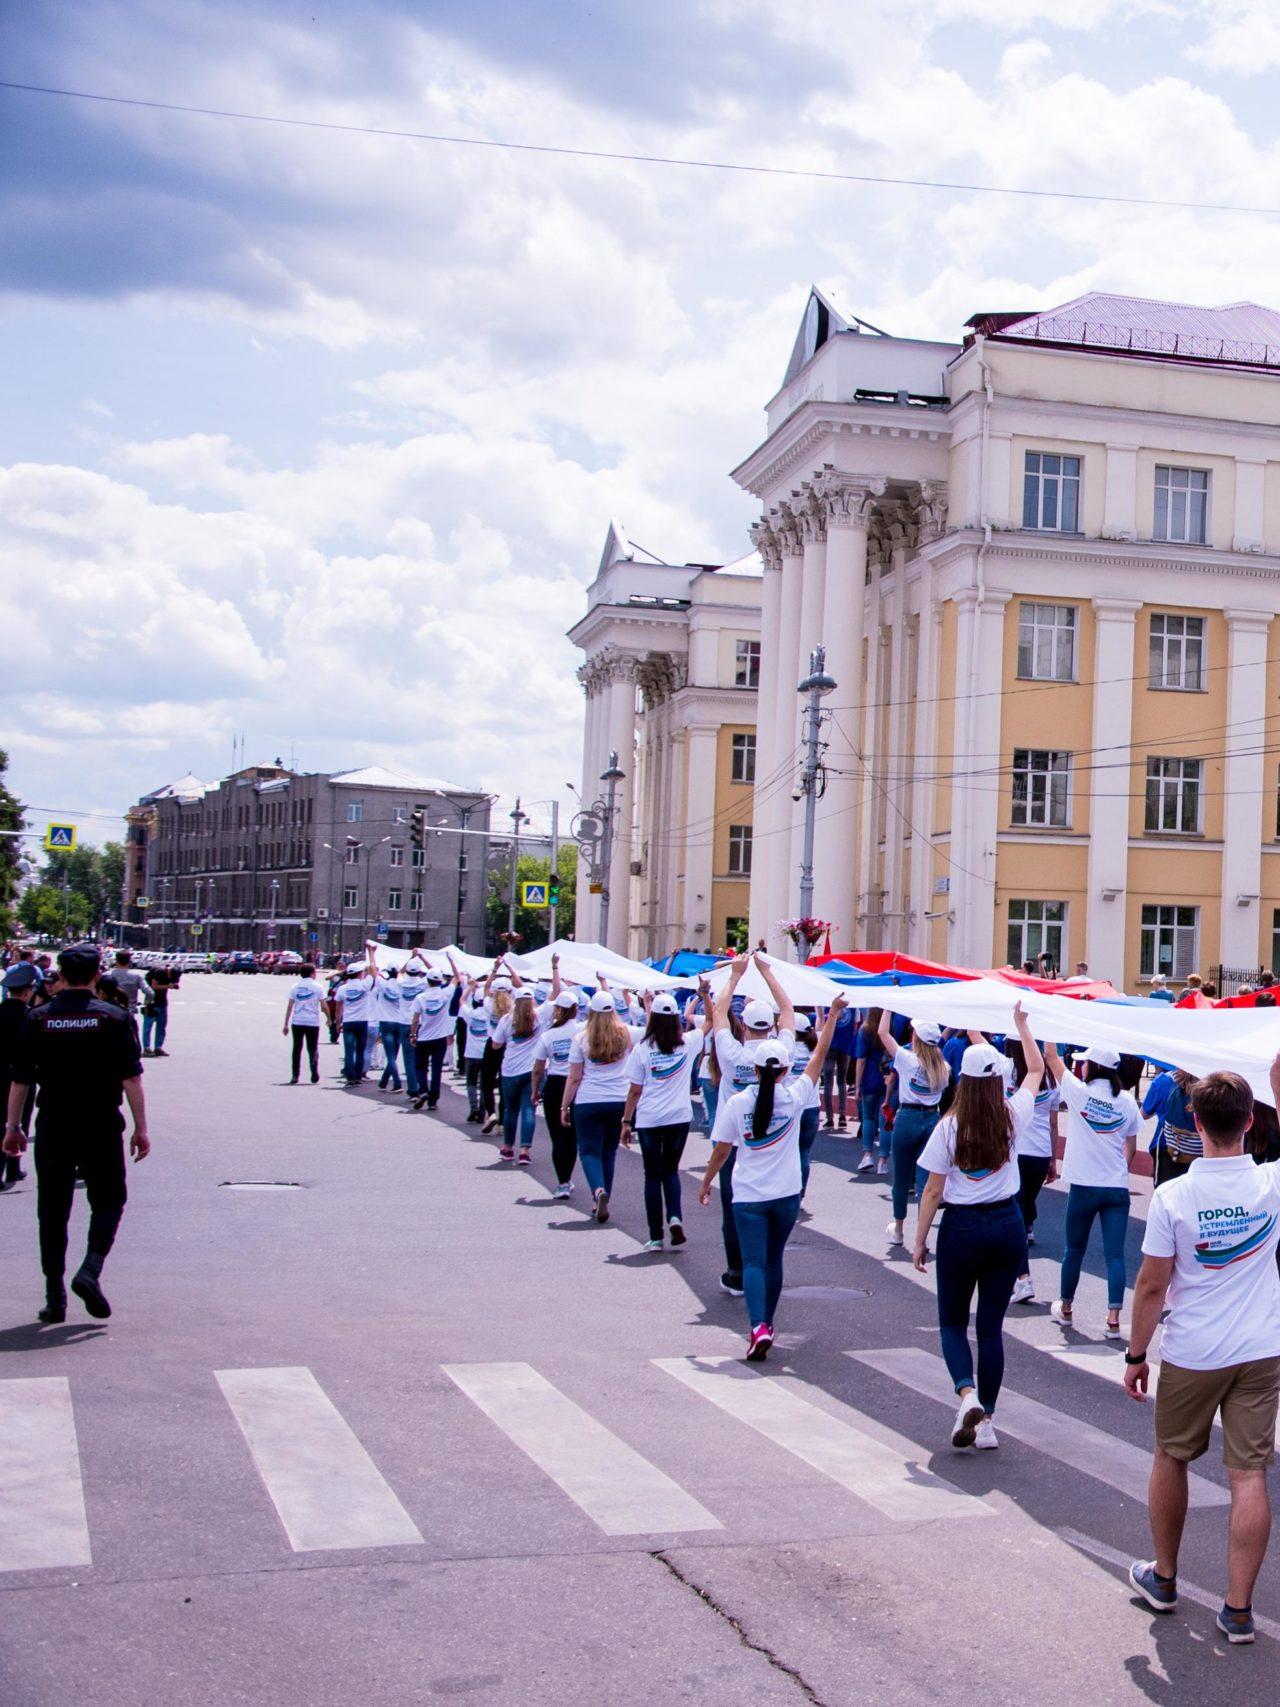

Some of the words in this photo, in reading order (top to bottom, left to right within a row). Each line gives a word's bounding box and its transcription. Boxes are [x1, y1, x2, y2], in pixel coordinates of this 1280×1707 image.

[47, 1019, 98, 1029] ПОЛИЦИЯ
[1197, 1206, 1250, 1222] ГОРОД,
[1199, 1210, 1268, 1231] УСТРЕМЛЕННЫЙ
[1207, 1225, 1249, 1238] БУДУЩЕЕ
